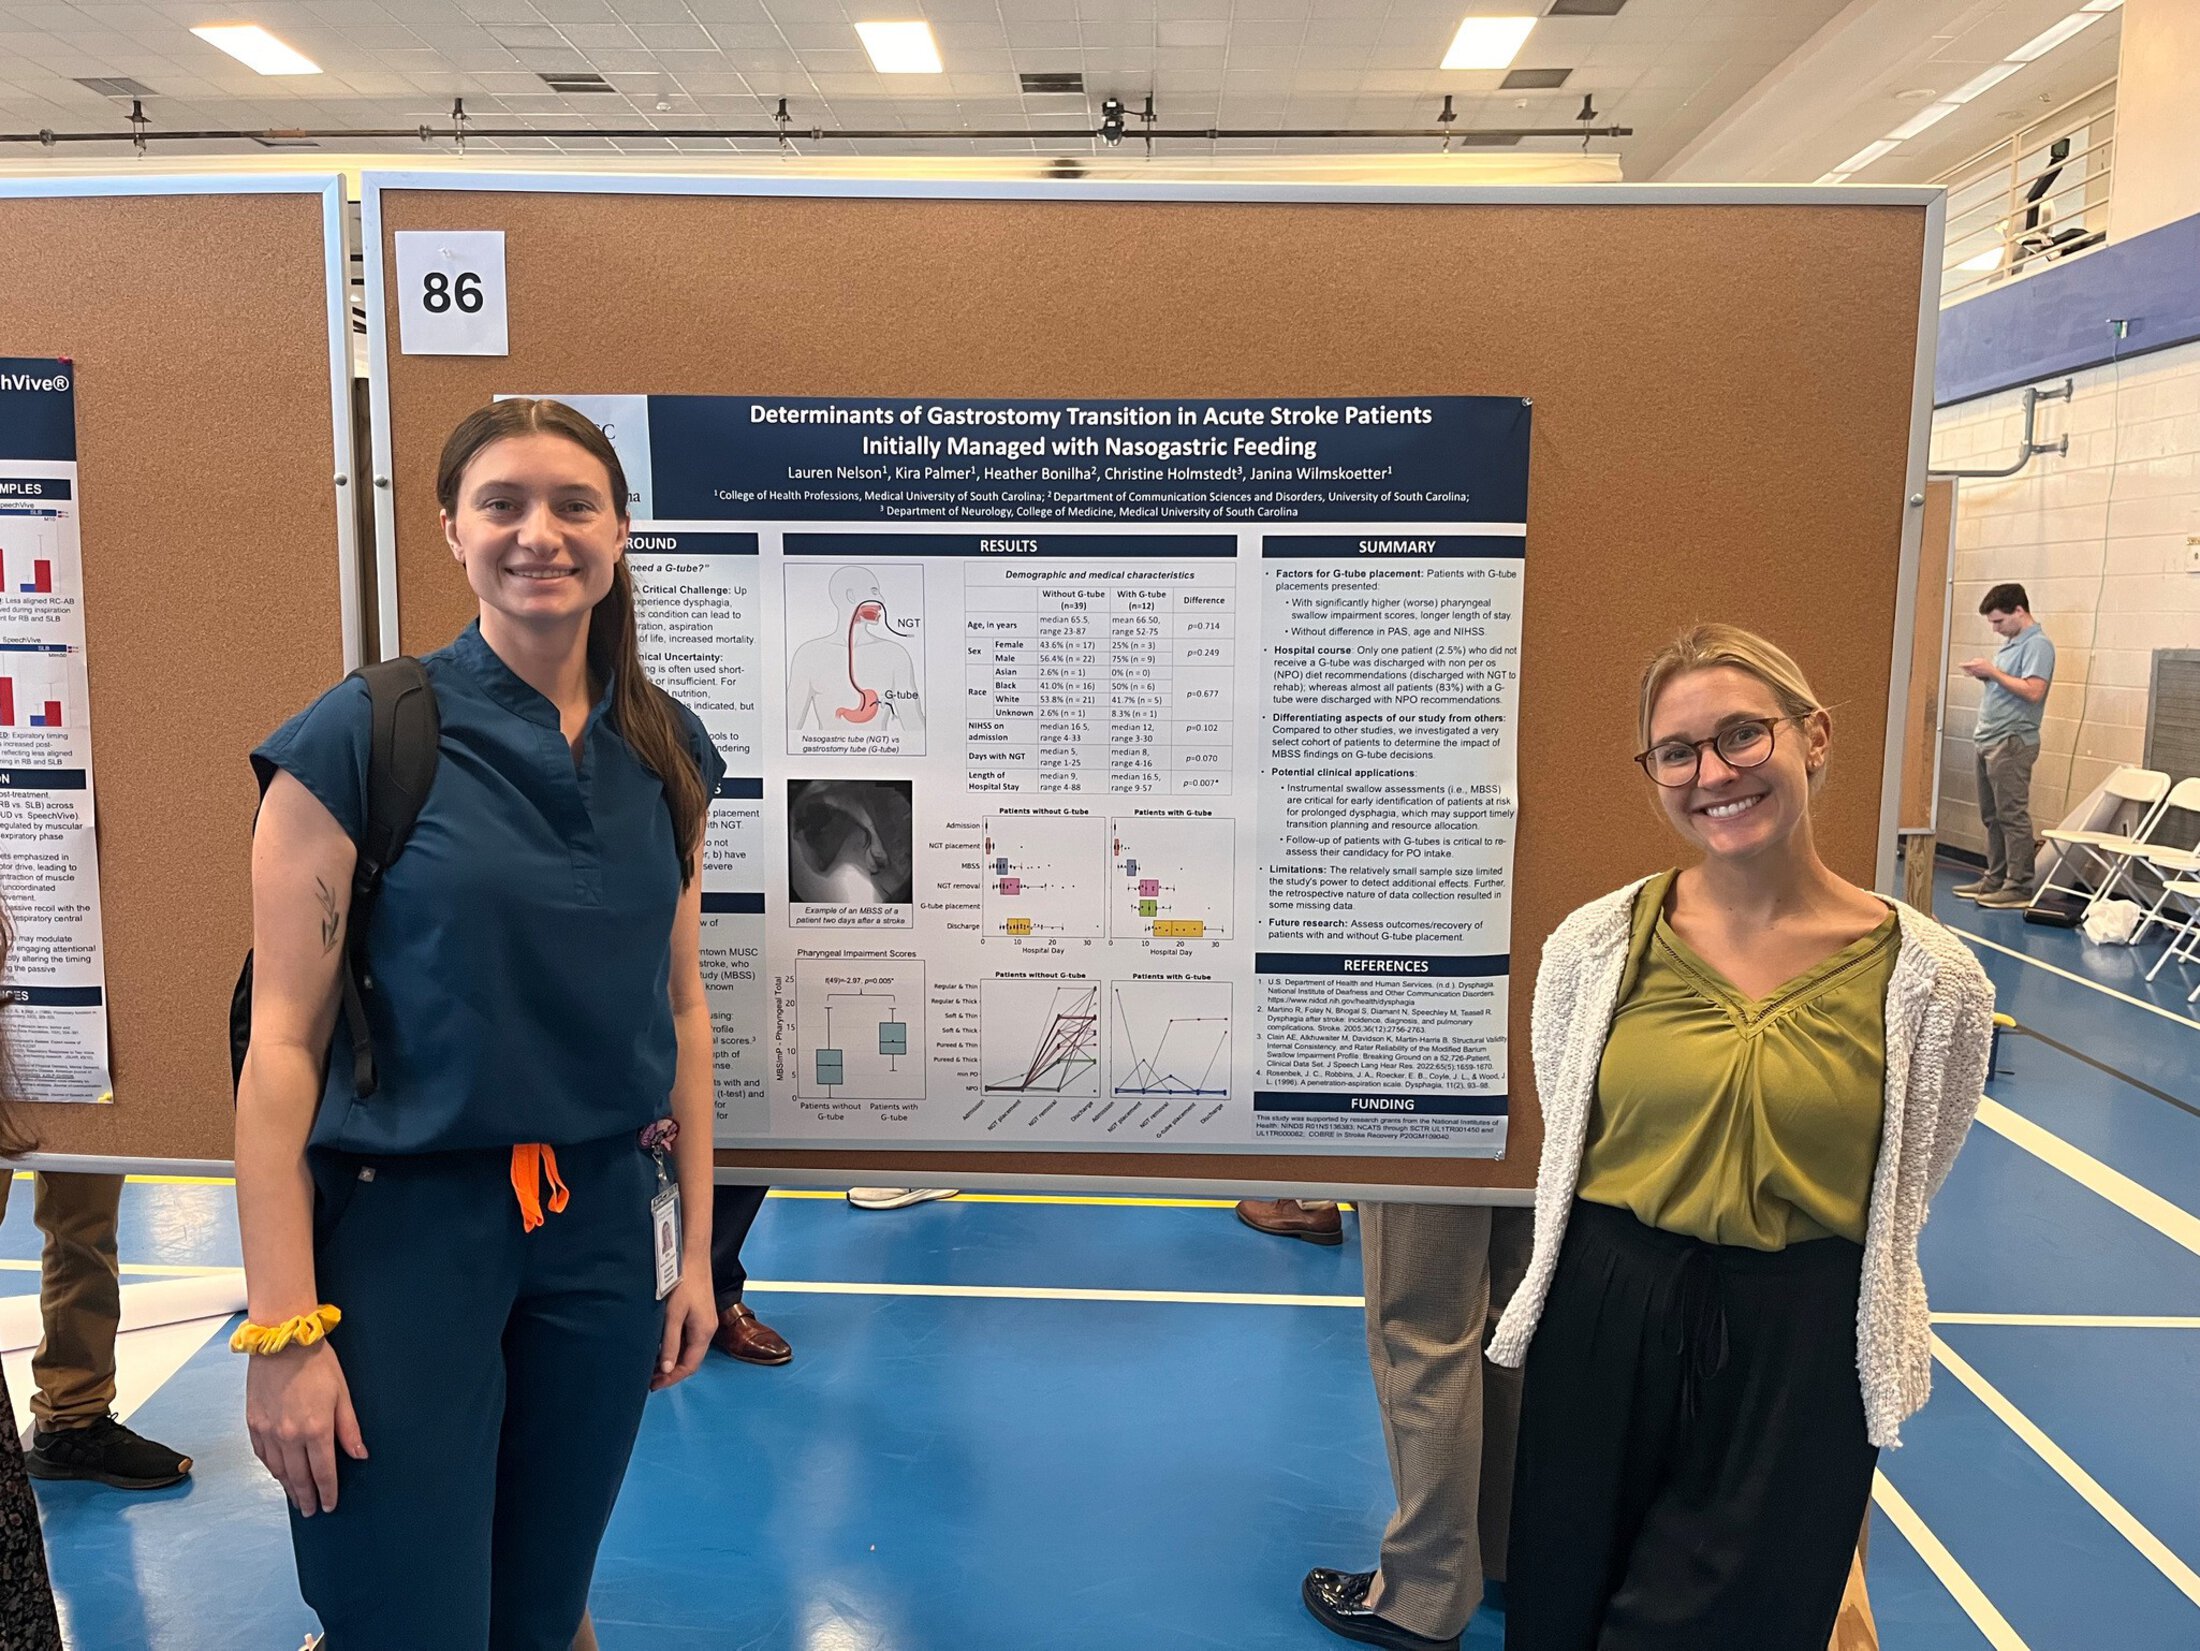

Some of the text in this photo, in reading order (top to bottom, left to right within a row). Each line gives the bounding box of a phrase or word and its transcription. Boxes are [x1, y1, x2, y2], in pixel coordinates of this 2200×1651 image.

[423, 272, 483, 314] 86
[750, 404, 1432, 429] Determinants of Gastrostomy Transition in Acute Stroke Patients
[863, 435, 1317, 460] Initially Managed with Nasogastric Feeding
[788, 466, 832, 478] Lauren
[895, 466, 920, 479] Kira
[984, 466, 1038, 479] Heather
[1104, 466, 1163, 480] Christine
[1249, 467, 1292, 480] Janina
[719, 489, 754, 502] College
[756, 489, 767, 500] of
[769, 490, 801, 500] Health
[804, 490, 862, 501] Professions,
[864, 490, 903, 500] Medical
[906, 491, 955, 502] University
[957, 490, 968, 501] of
[970, 490, 998, 502] South
[1001, 490, 1044, 502] Carolina;
[1053, 491, 1113, 503] Department
[1115, 491, 1126, 501] of
[1128, 491, 1206, 501] Communication
[1209, 491, 1251, 501] Sciences
[1253, 491, 1273, 501] and
[1275, 491, 1325, 502] Disorders,
[1328, 491, 1378, 503] University
[1380, 490, 1391, 501] of
[1393, 491, 1422, 501] South
[1425, 491, 1469, 502] Carolina;
[886, 505, 945, 517] Department
[948, 505, 959, 515] of
[961, 506, 1014, 518] Neurology,
[1016, 506, 1052, 518] College
[1054, 506, 1066, 516] of
[1067, 506, 1116, 517] Medicine,
[1119, 506, 1158, 516] Medical
[1161, 507, 1211, 518] University
[1212, 506, 1223, 516] of
[1225, 506, 1254, 516] South
[1257, 506, 1298, 516] Carolina
[980, 540, 1038, 552] RESULTS
[1359, 540, 1436, 553] SUMMARY
[1005, 570, 1194, 580] Demographic and medical characteristics
[1276, 568, 1516, 580] Factors for G-tube placement: Patients with G-tube
[642, 585, 747, 596] Critical Challenge: Up
[1077, 590, 1105, 598] G-tube
[1138, 590, 1166, 598] G-tube
[1184, 597, 1225, 605] Difference
[1061, 602, 1087, 611] (n=39)
[1128, 602, 1155, 611] (n=12)
[897, 619, 921, 628] NGT
[967, 621, 984, 630] Age,
[996, 622, 1017, 630] years
[640, 634, 648, 643] of
[669, 634, 713, 643] increased
[995, 640, 1023, 648] Female
[664, 652, 723, 663] Uncertainty:
[884, 690, 919, 699] G-tube
[739, 701, 754, 710] but
[1272, 714, 1341, 724] Differentiating
[1344, 714, 1383, 723] aspects
[1386, 713, 1396, 722] of
[1418, 713, 1446, 724] study
[1448, 713, 1471, 722] from
[1474, 713, 1505, 722] others:
[968, 752, 987, 760] Days
[1008, 752, 1025, 760] NGT
[1271, 767, 1314, 776] Potential
[1317, 767, 1351, 776] clinical
[969, 783, 1020, 792] Hospital Stay
[1268, 917, 1300, 927] Future
[1302, 919, 1347, 927] research:
[1350, 920, 1383, 929] Assess
[1474, 921, 1483, 929] of
[729, 948, 758, 957] MUSC
[797, 949, 917, 958] Pharyngeal Impairment Scores
[1344, 959, 1429, 972] REFERENCES
[774, 976, 782, 995] Total
[748, 1090, 765, 1099] and
[800, 1102, 861, 1110] Patients without
[869, 1102, 900, 1110] Patients
[1351, 1098, 1414, 1111] FUNDING
[817, 1113, 844, 1121] G-tube
[880, 1113, 908, 1121] G-tube
